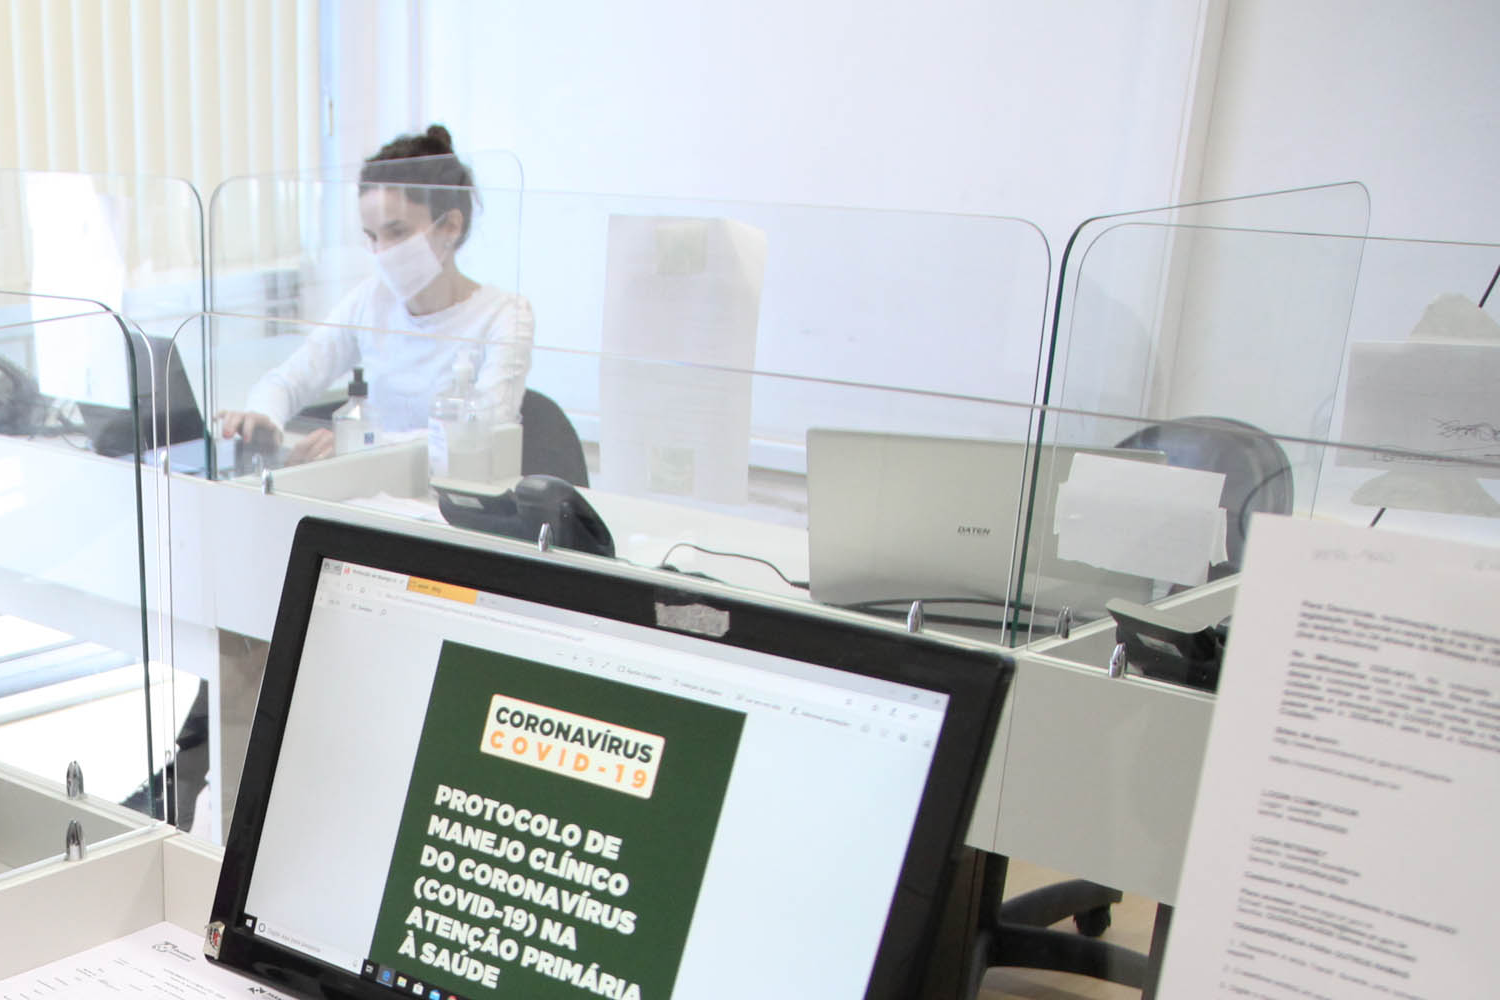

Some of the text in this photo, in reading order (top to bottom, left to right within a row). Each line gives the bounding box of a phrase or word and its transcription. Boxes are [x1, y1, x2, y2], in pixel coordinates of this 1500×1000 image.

[957, 525, 991, 536] DATEN
[490, 730, 647, 789] COVID-19
[495, 706, 654, 764] CORONAVÍRUS
[434, 784, 623, 861] PROTOCOLO DE
[427, 814, 630, 897] MANEJO CLÍNICO
[414, 875, 577, 951] (COVID-19) NA
[420, 844, 637, 935] DO CORONAVÍRUS
[398, 930, 501, 989] À SAÚDE
[405, 905, 519, 962] ATENÇÃO
